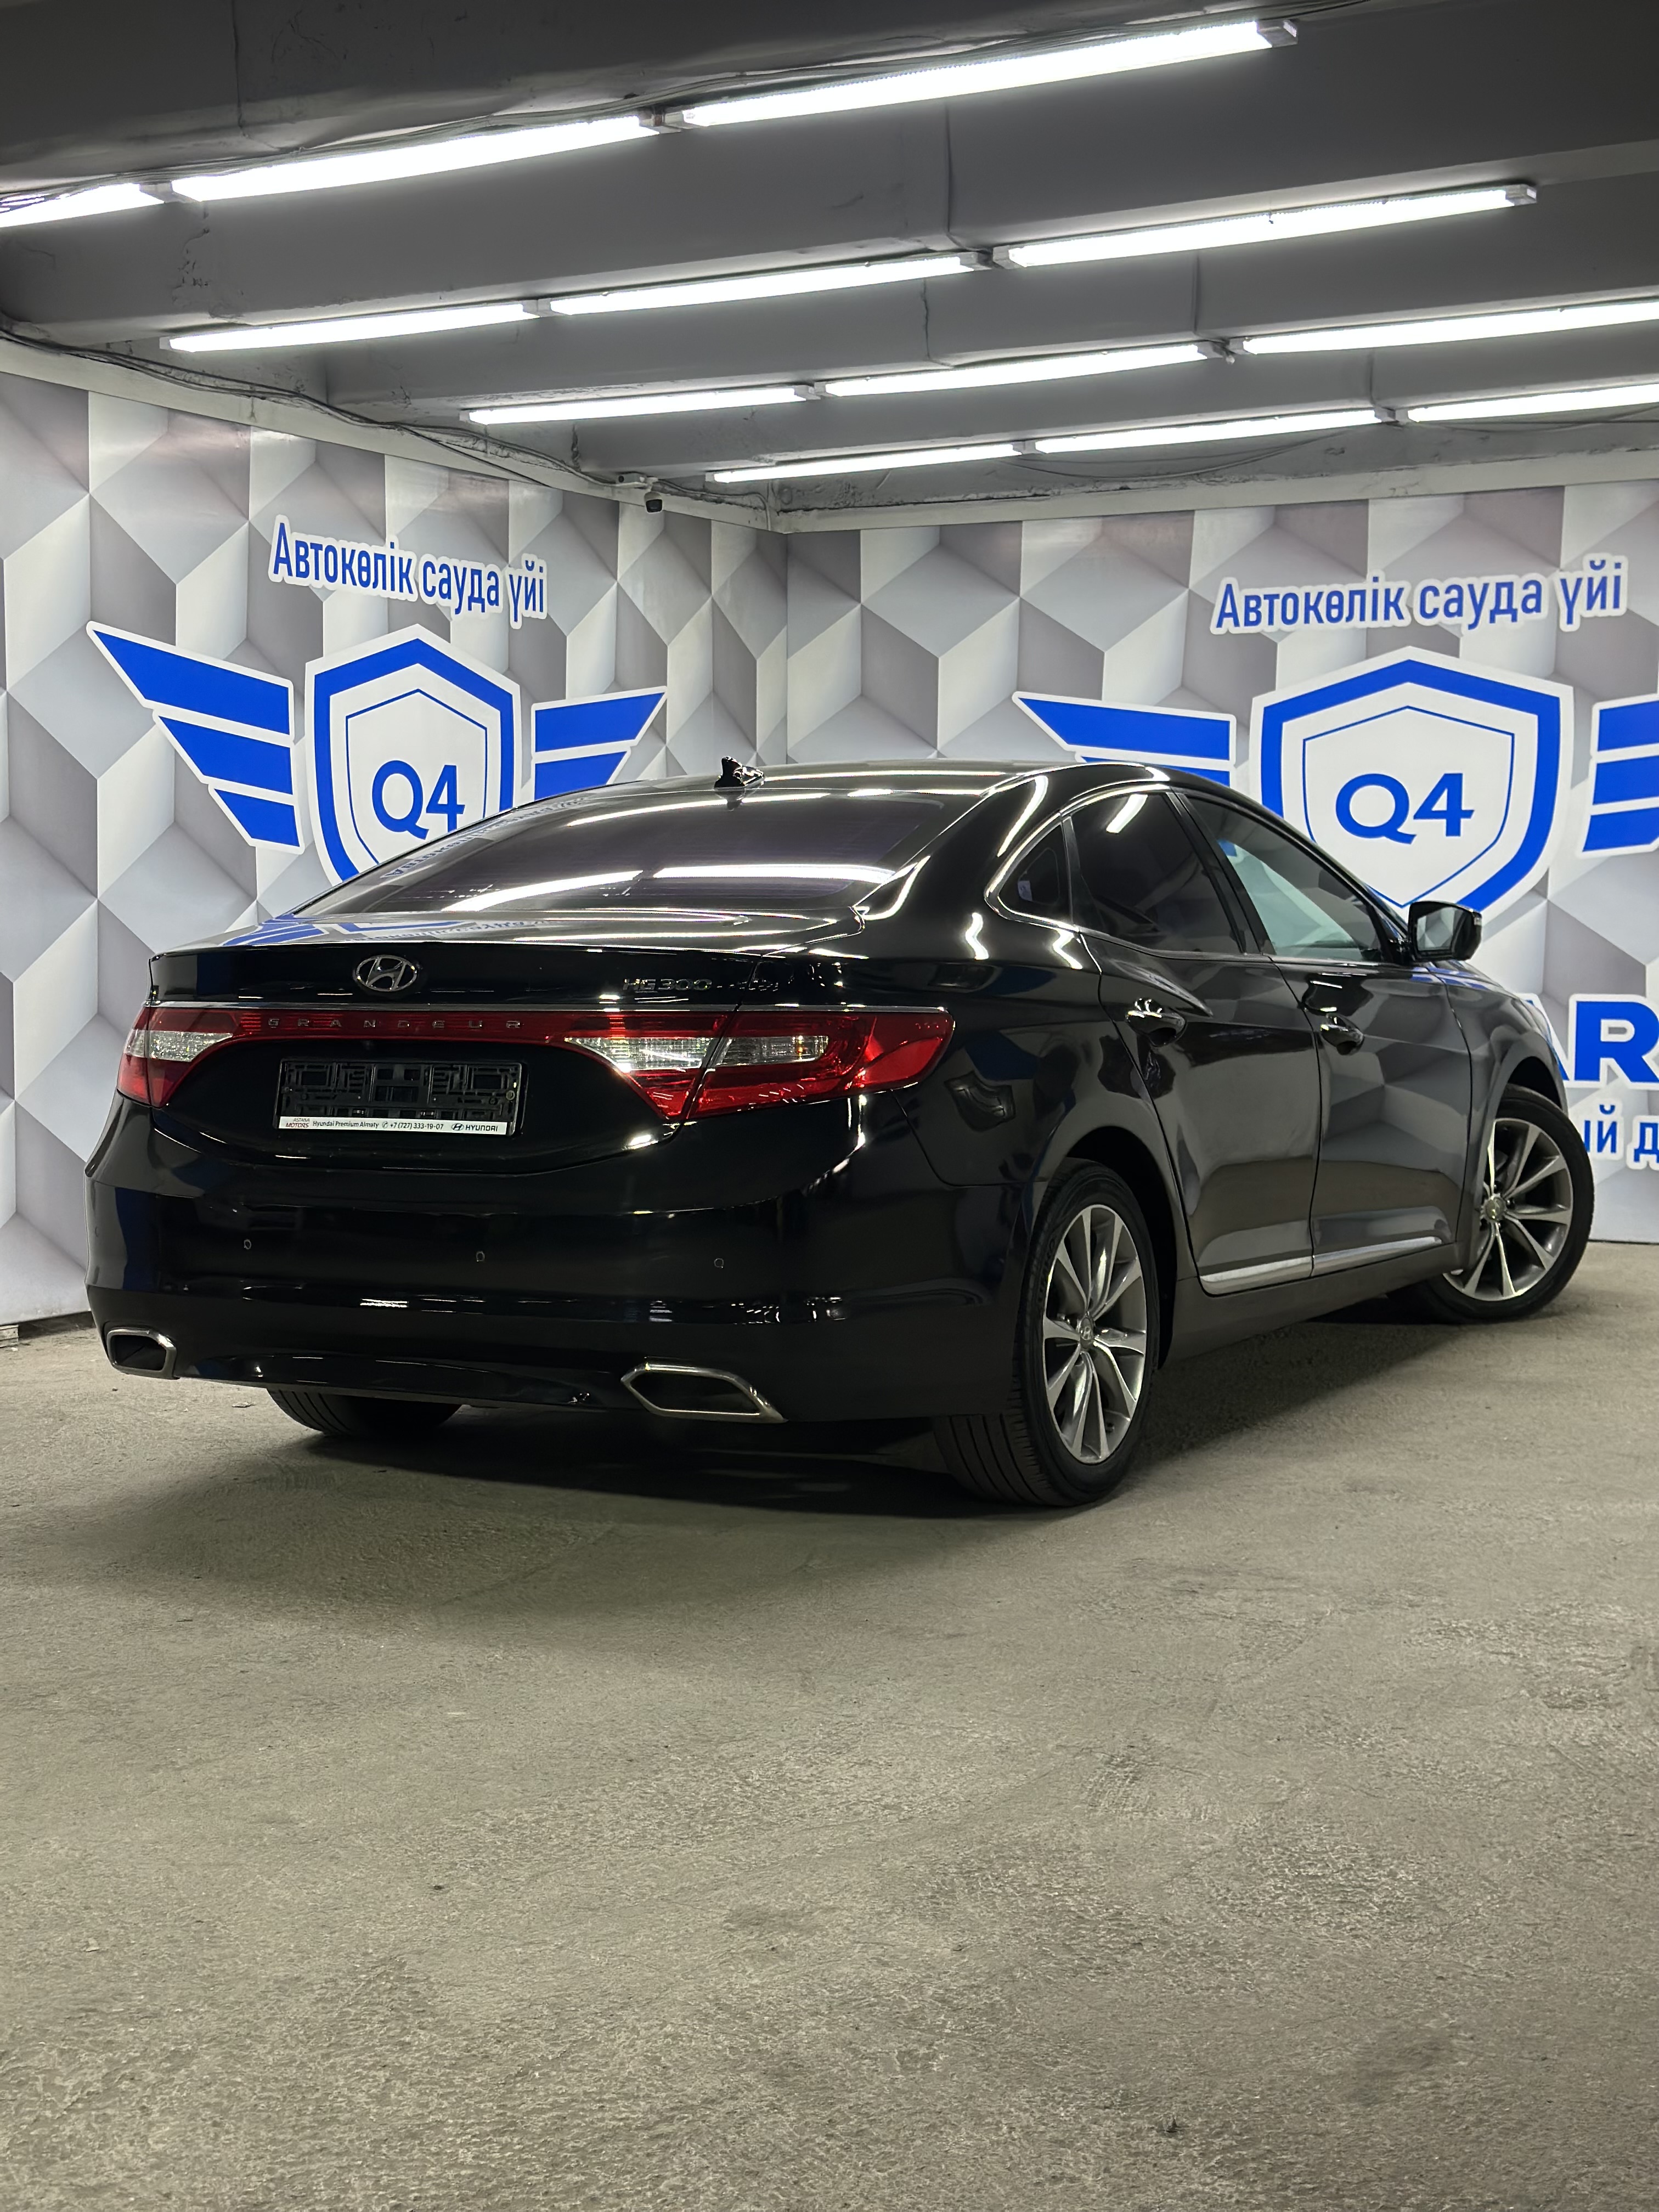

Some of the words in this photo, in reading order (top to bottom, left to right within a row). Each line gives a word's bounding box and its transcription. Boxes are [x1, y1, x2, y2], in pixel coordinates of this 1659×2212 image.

[273, 522, 414, 595] Автокөлік
[422, 561, 500, 615] сауда
[509, 561, 544, 622] үйі
[1216, 576, 1404, 629] Автокөлік
[1419, 580, 1542, 630] сауда
[1560, 561, 1621, 625] үйі
[371, 759, 466, 840] Q4
[1335, 772, 1475, 845] Q4
[268, 1018, 521, 1029] GRANDEUR
[1526, 1000, 1659, 1084] R
